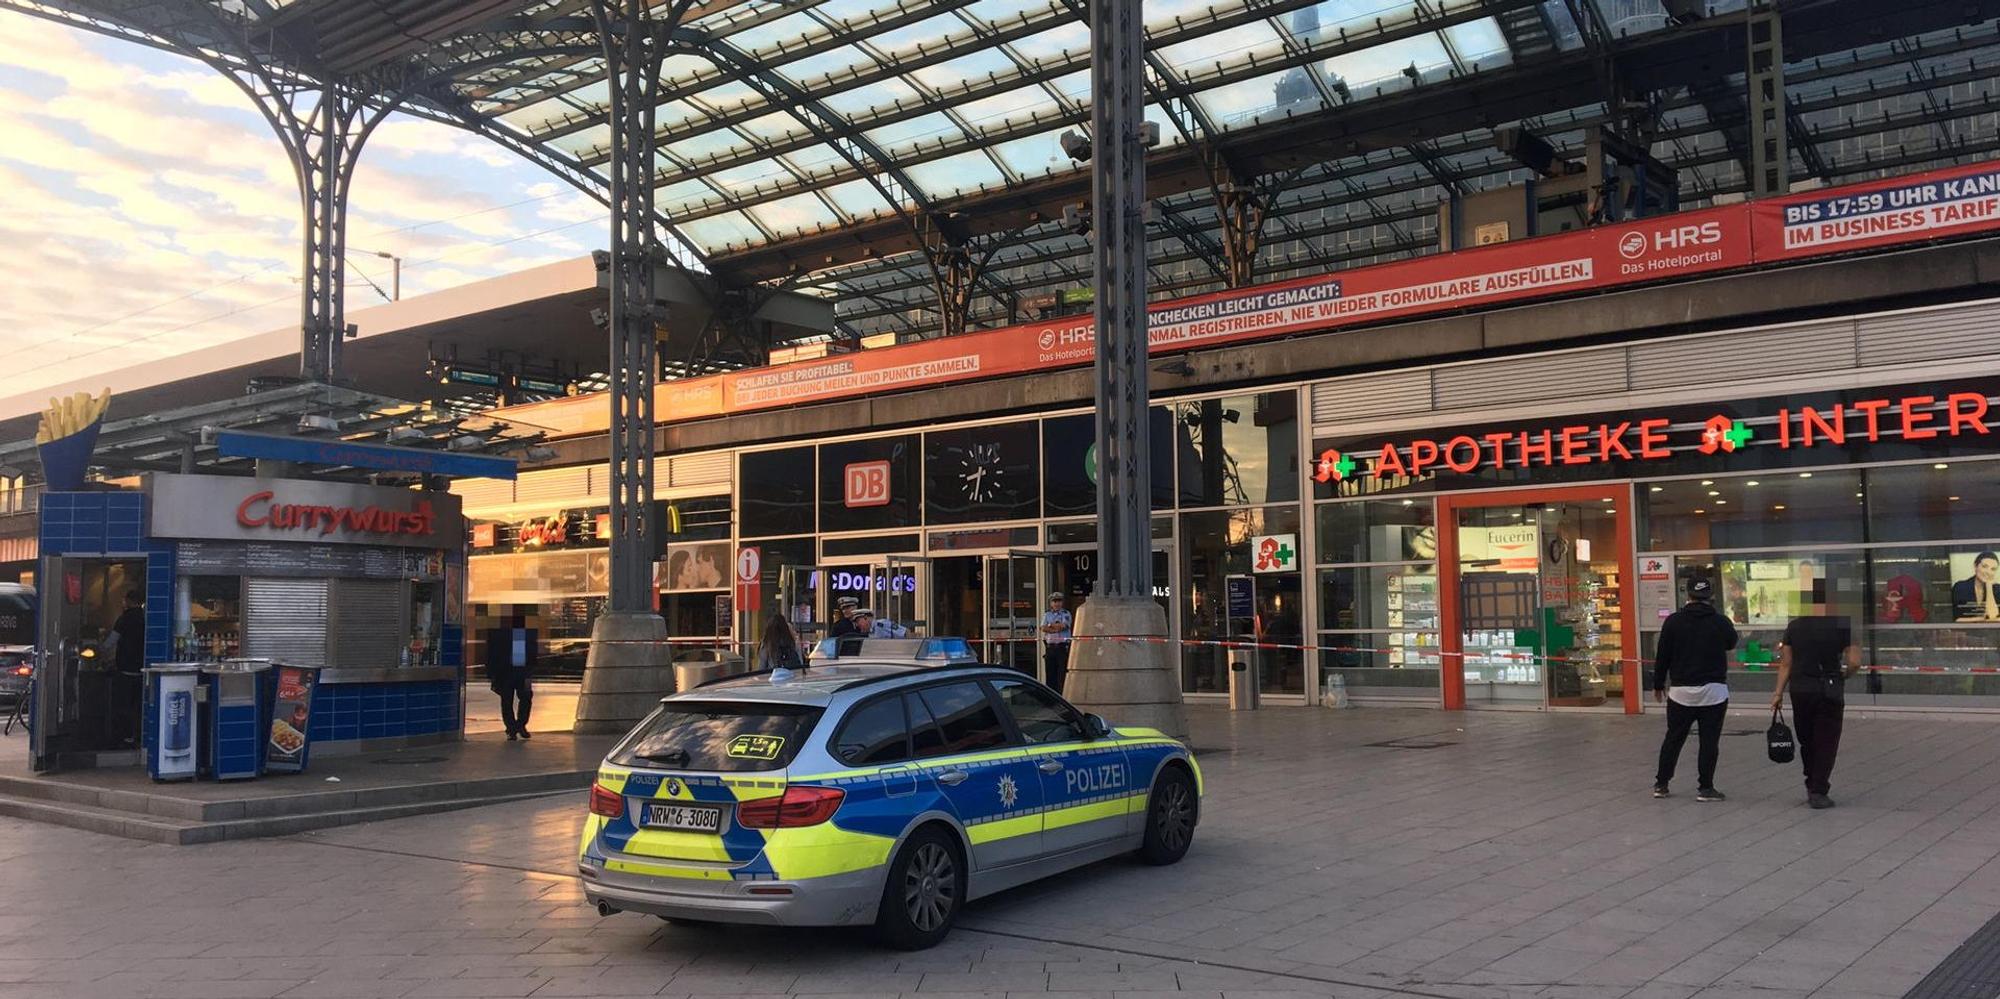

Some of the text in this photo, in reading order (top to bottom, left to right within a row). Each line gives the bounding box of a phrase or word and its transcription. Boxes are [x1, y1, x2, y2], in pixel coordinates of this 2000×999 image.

[1787, 174, 2000, 223] BIS 17:59 UHR KAN
[1655, 222, 1721, 251] HRS
[1789, 199, 1998, 245] IM BUSINESS TARIF
[1622, 250, 1722, 275] Das Hotelportal
[1149, 262, 1590, 343] NMAL REGISTRIEREN, NIE WIEDER FORMULARE AUSFÜLLEN.
[1149, 284, 1340, 326] NCHECKEN LEICHT GEMACHT:
[1040, 346, 1096, 362] Das Hotelporta
[737, 362, 853, 389] SCHLAFEN SIE PROFITABEL:
[752, 387, 780, 401] JEDER
[780, 381, 821, 396] BUCHUNG
[823, 375, 857, 390] MEILEN
[860, 373, 880, 384] UND
[882, 367, 920, 381] PUNKTE
[921, 357, 978, 375] SAMMELN.
[1778, 392, 1990, 449] INTER
[1373, 418, 1673, 479] APOTHEKE
[851, 468, 885, 500] DB
[236, 490, 436, 535] Currywurst
[1488, 531, 1534, 544] Eucerin
[1074, 554, 1090, 572] 10
[1152, 586, 1170, 597] ALS
[630, 775, 660, 785] POLIZEI
[1065, 763, 1126, 794] POLIZEI
[649, 807, 718, 828] NRW 6-3080
